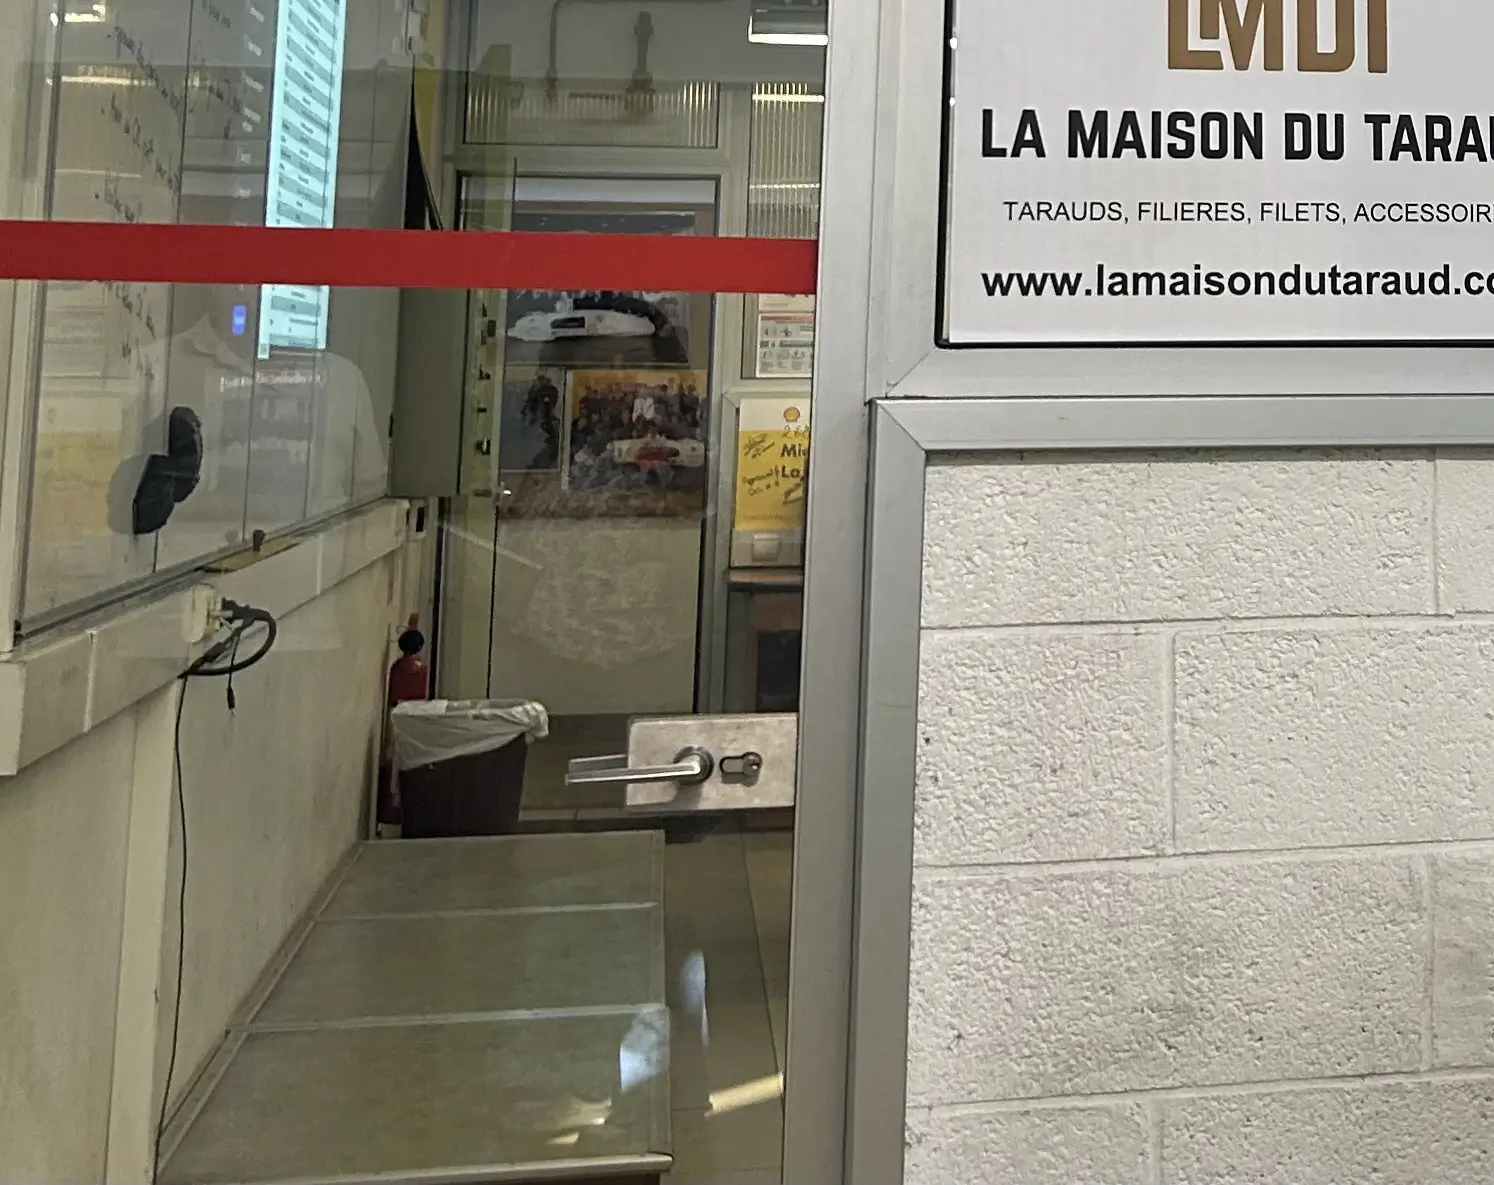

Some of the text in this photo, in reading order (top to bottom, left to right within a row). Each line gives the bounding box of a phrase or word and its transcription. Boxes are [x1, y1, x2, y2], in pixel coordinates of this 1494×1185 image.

[982, 109, 1046, 158] LA
[1068, 110, 1262, 159] MAISON
[1285, 113, 1344, 160] DU
[1003, 202, 1128, 224] TARAUDS,
[1138, 202, 1251, 224] FILIERES,
[1261, 203, 1345, 225] FILETS,
